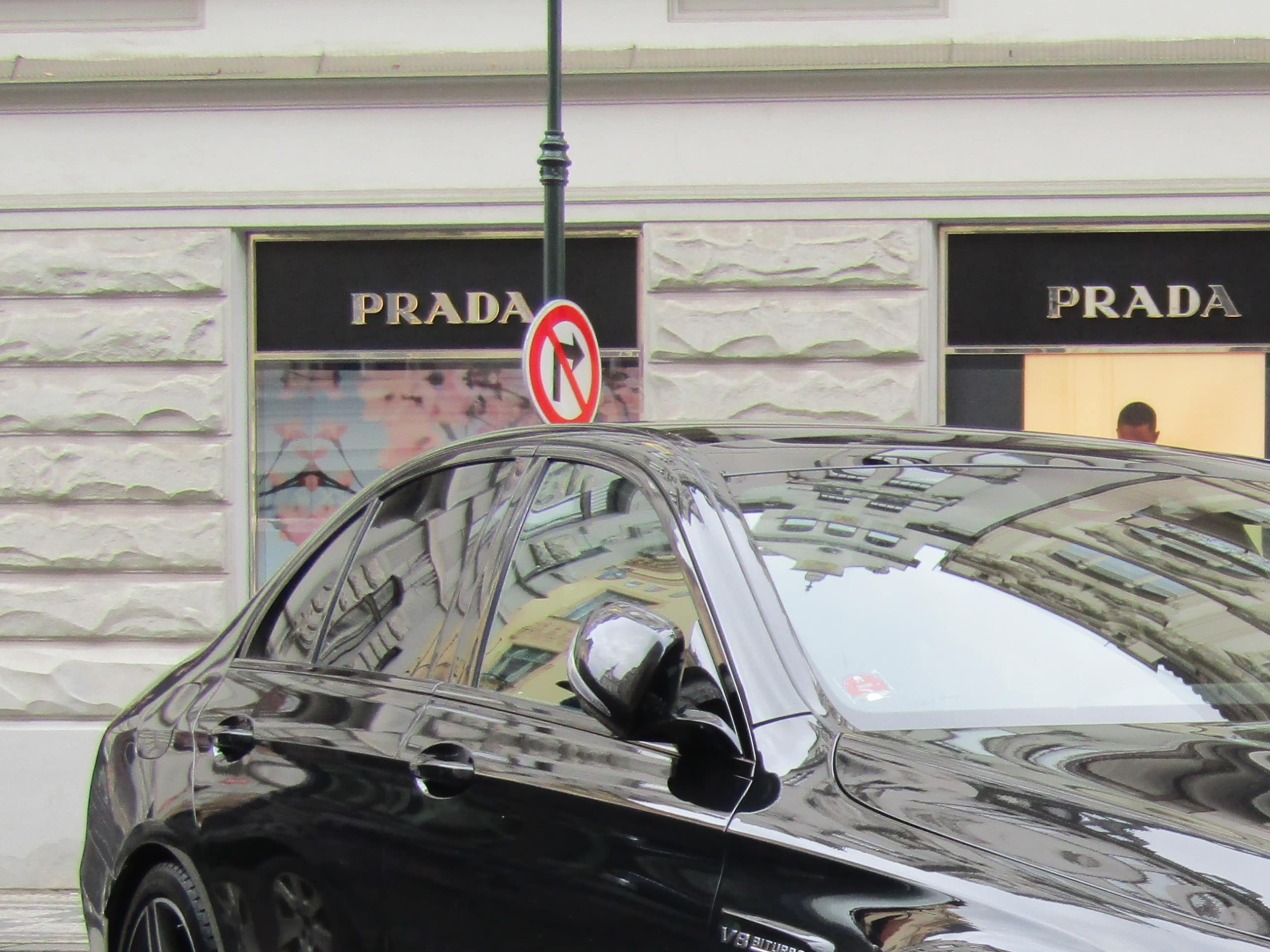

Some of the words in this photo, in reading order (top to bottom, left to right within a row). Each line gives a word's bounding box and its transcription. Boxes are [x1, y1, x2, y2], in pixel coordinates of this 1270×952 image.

[350, 291, 535, 325] PRADA
[1047, 284, 1242, 318] PRADA
[720, 926, 750, 948] V8
